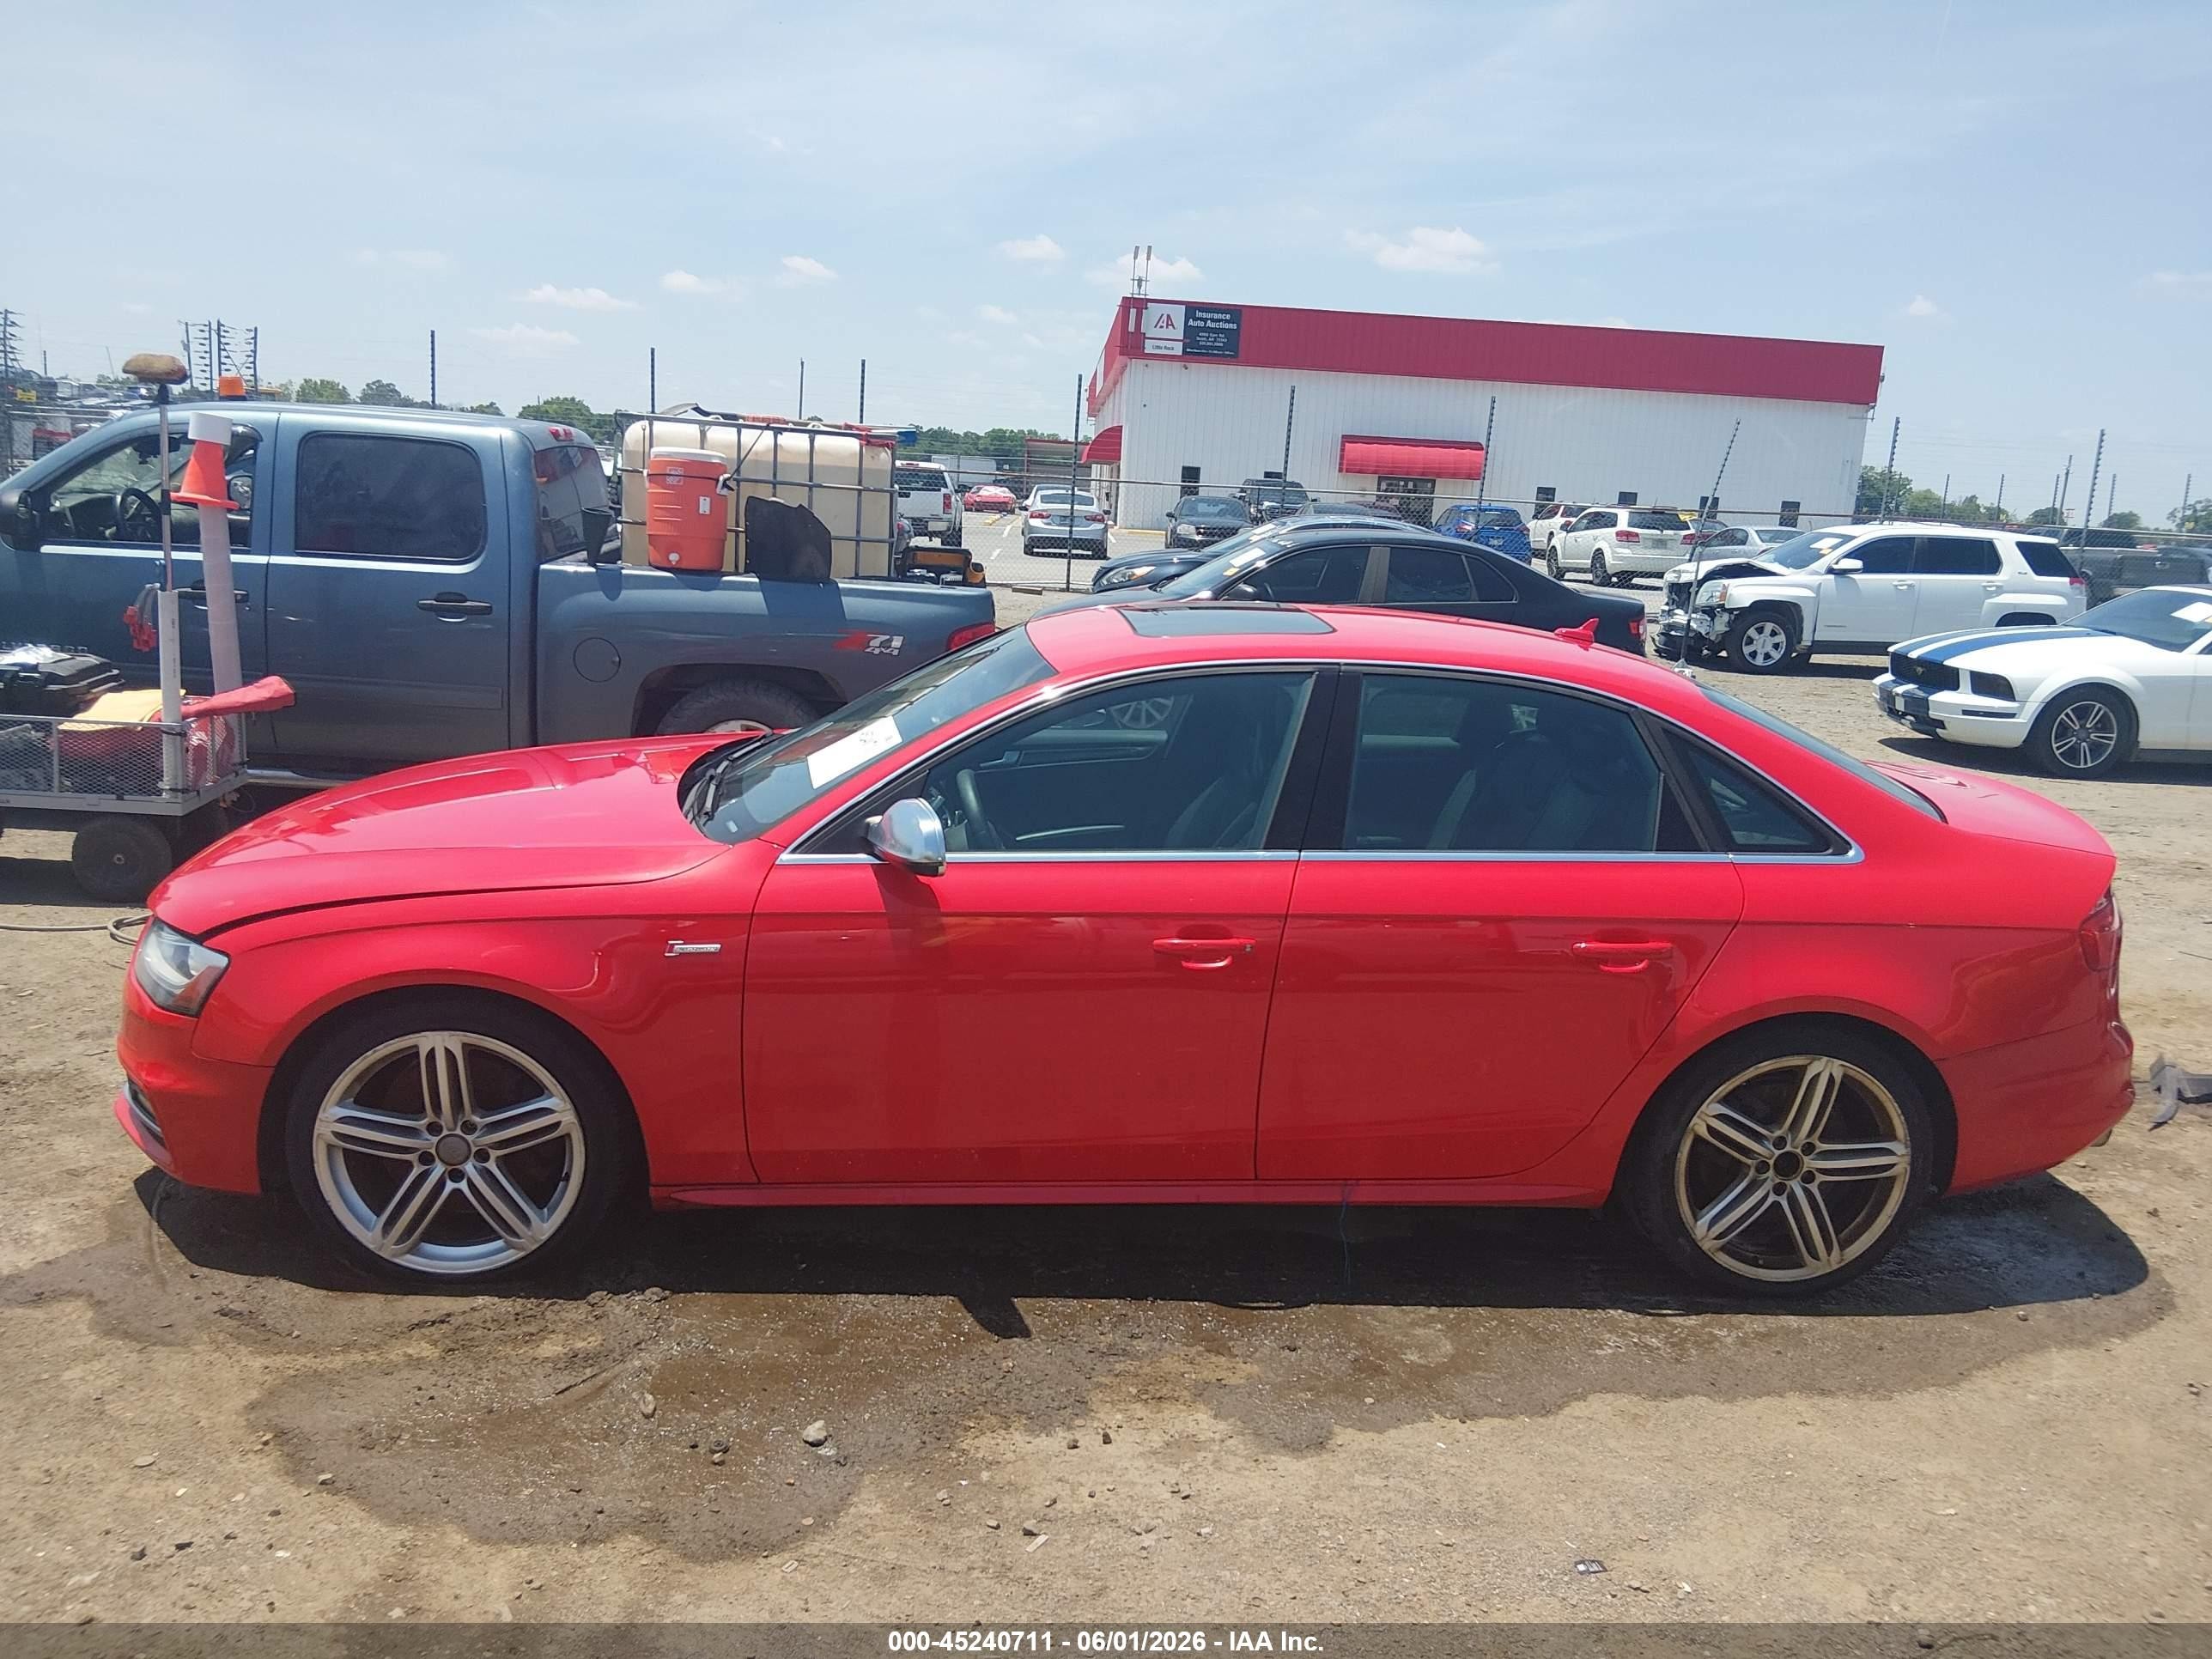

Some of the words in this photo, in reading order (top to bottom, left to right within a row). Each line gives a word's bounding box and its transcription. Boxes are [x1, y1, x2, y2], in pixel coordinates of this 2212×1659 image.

[1195, 310, 1231, 320] Insurance
[1188, 319, 1205, 327] Auto
[1206, 320, 1237, 330] Auctions
